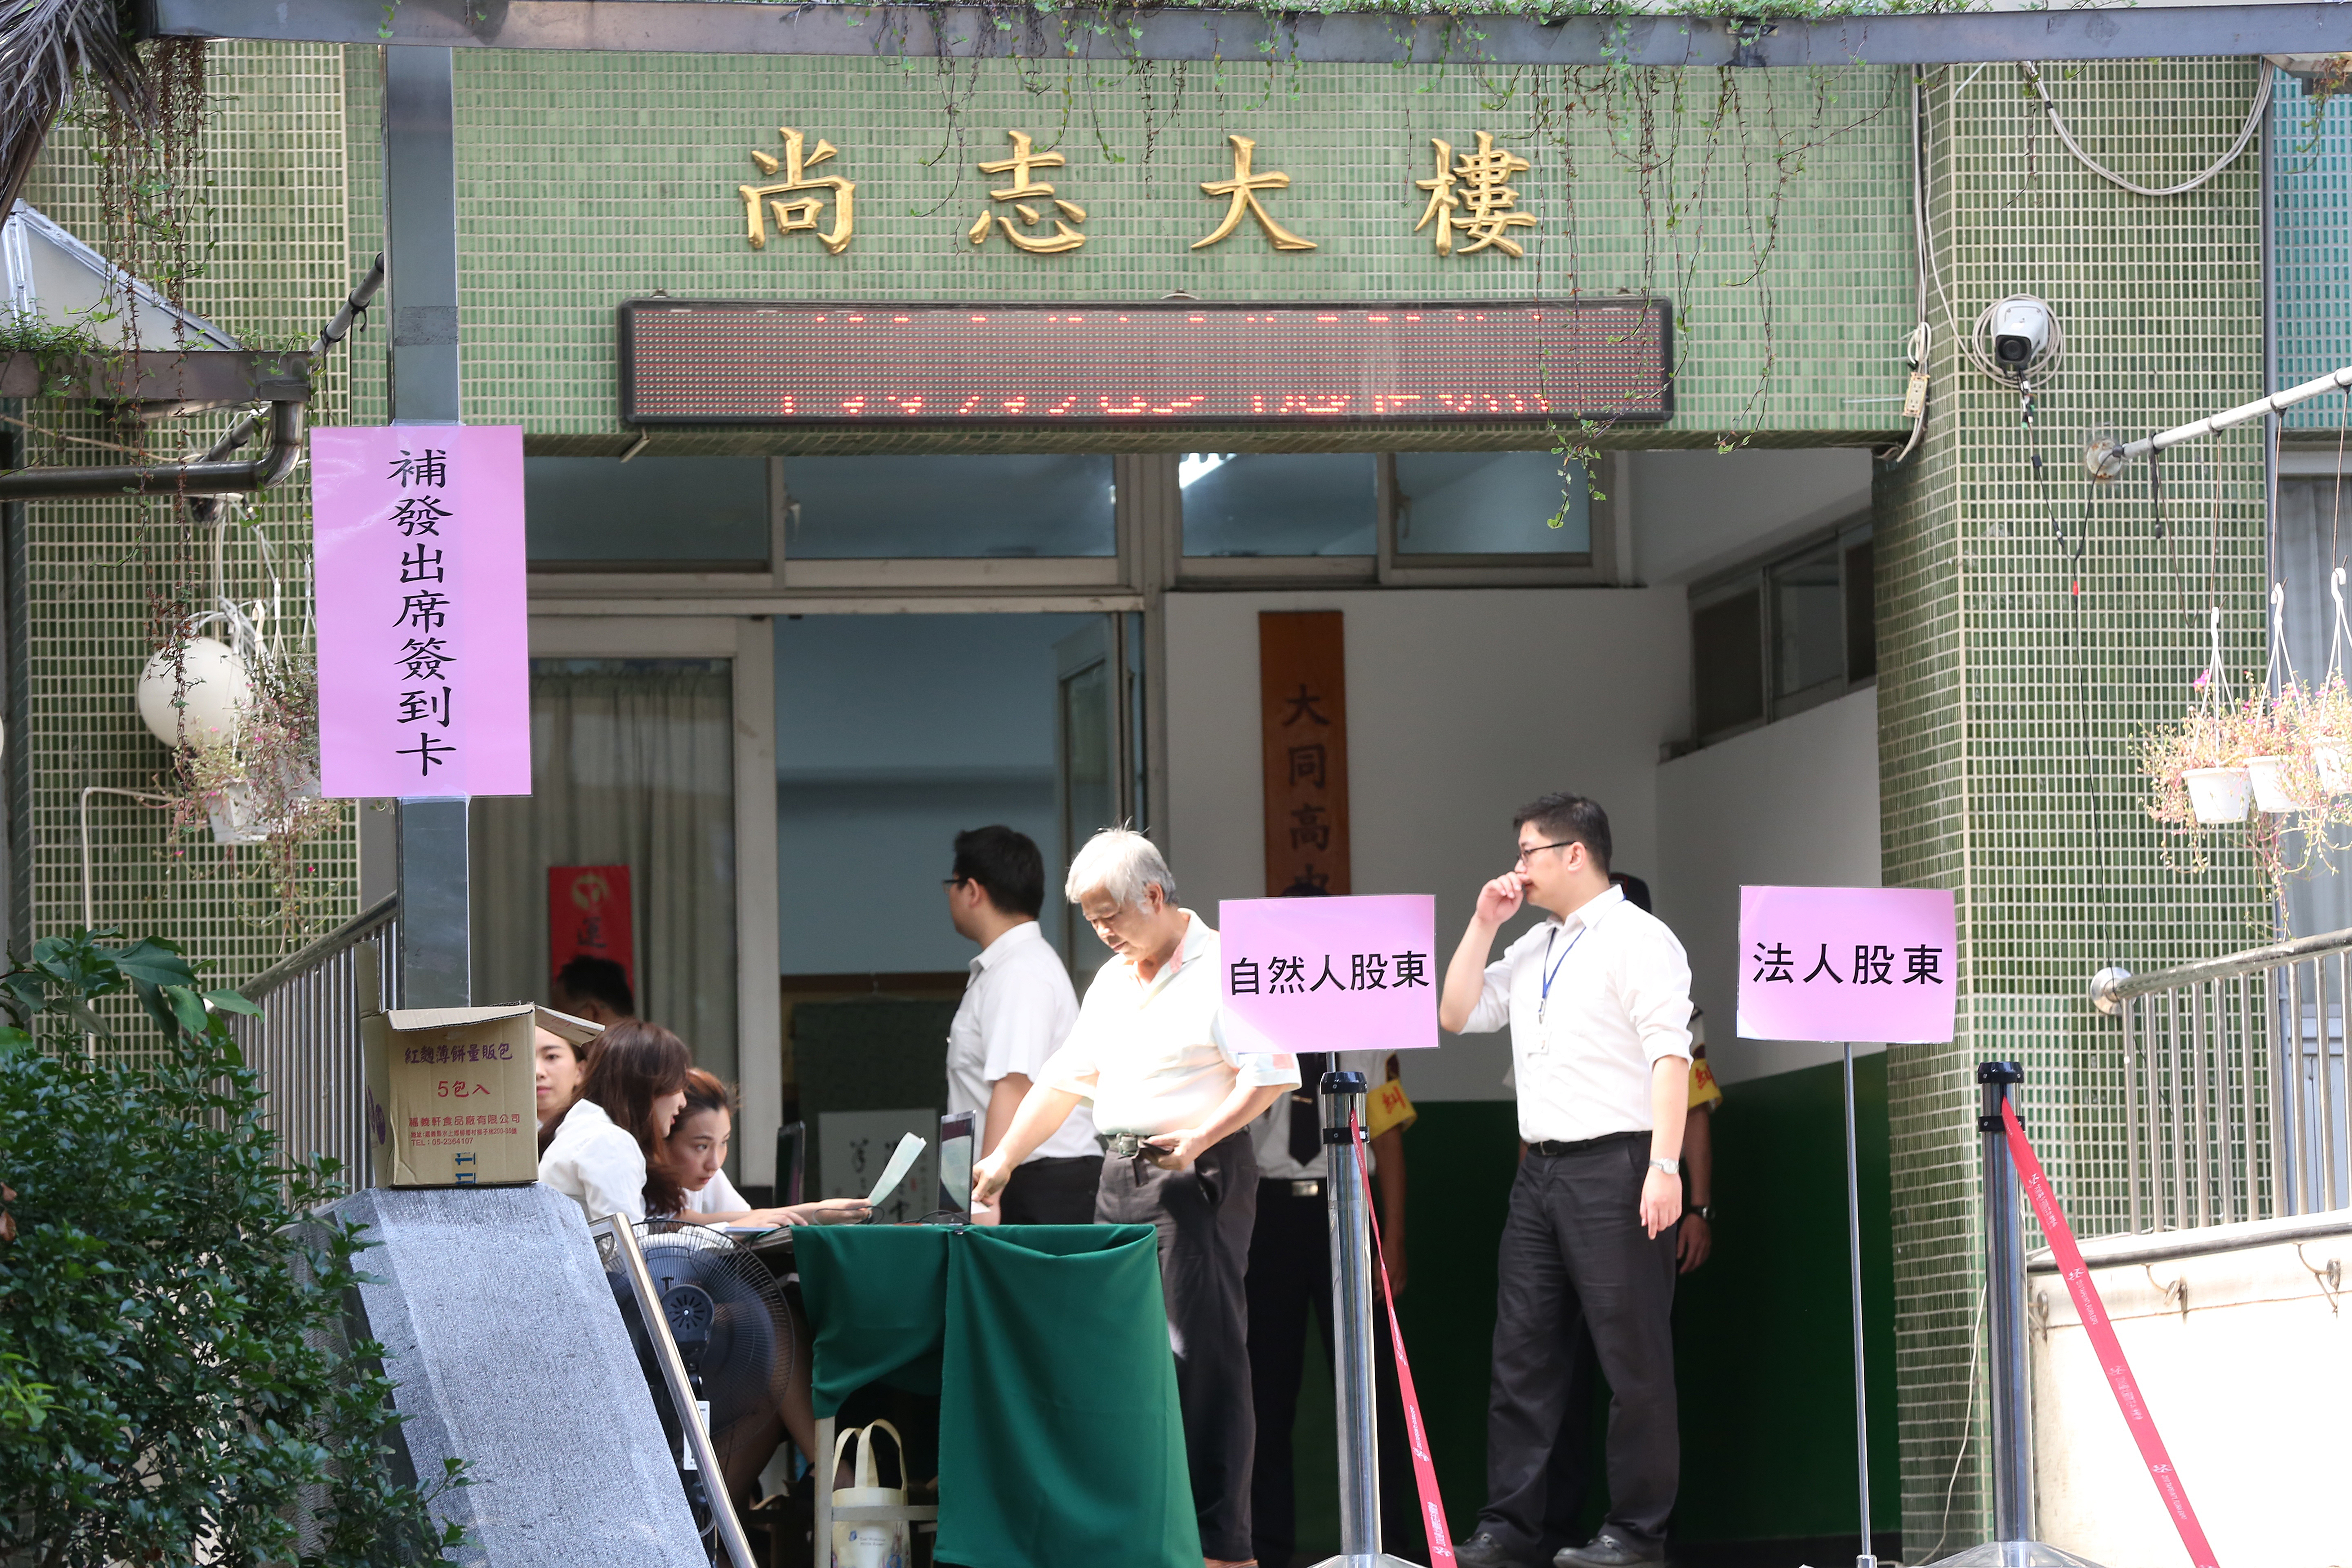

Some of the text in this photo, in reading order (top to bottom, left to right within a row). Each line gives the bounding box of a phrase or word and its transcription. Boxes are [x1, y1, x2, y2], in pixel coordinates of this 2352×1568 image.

[738, 127, 1537, 257] 尚志大樓
[386, 449, 457, 777] 補發出席簽到卡
[1231, 950, 1430, 996] 自然人股東
[1753, 942, 1944, 985] 法人股東
[437, 1080, 490, 1097] 5包入
